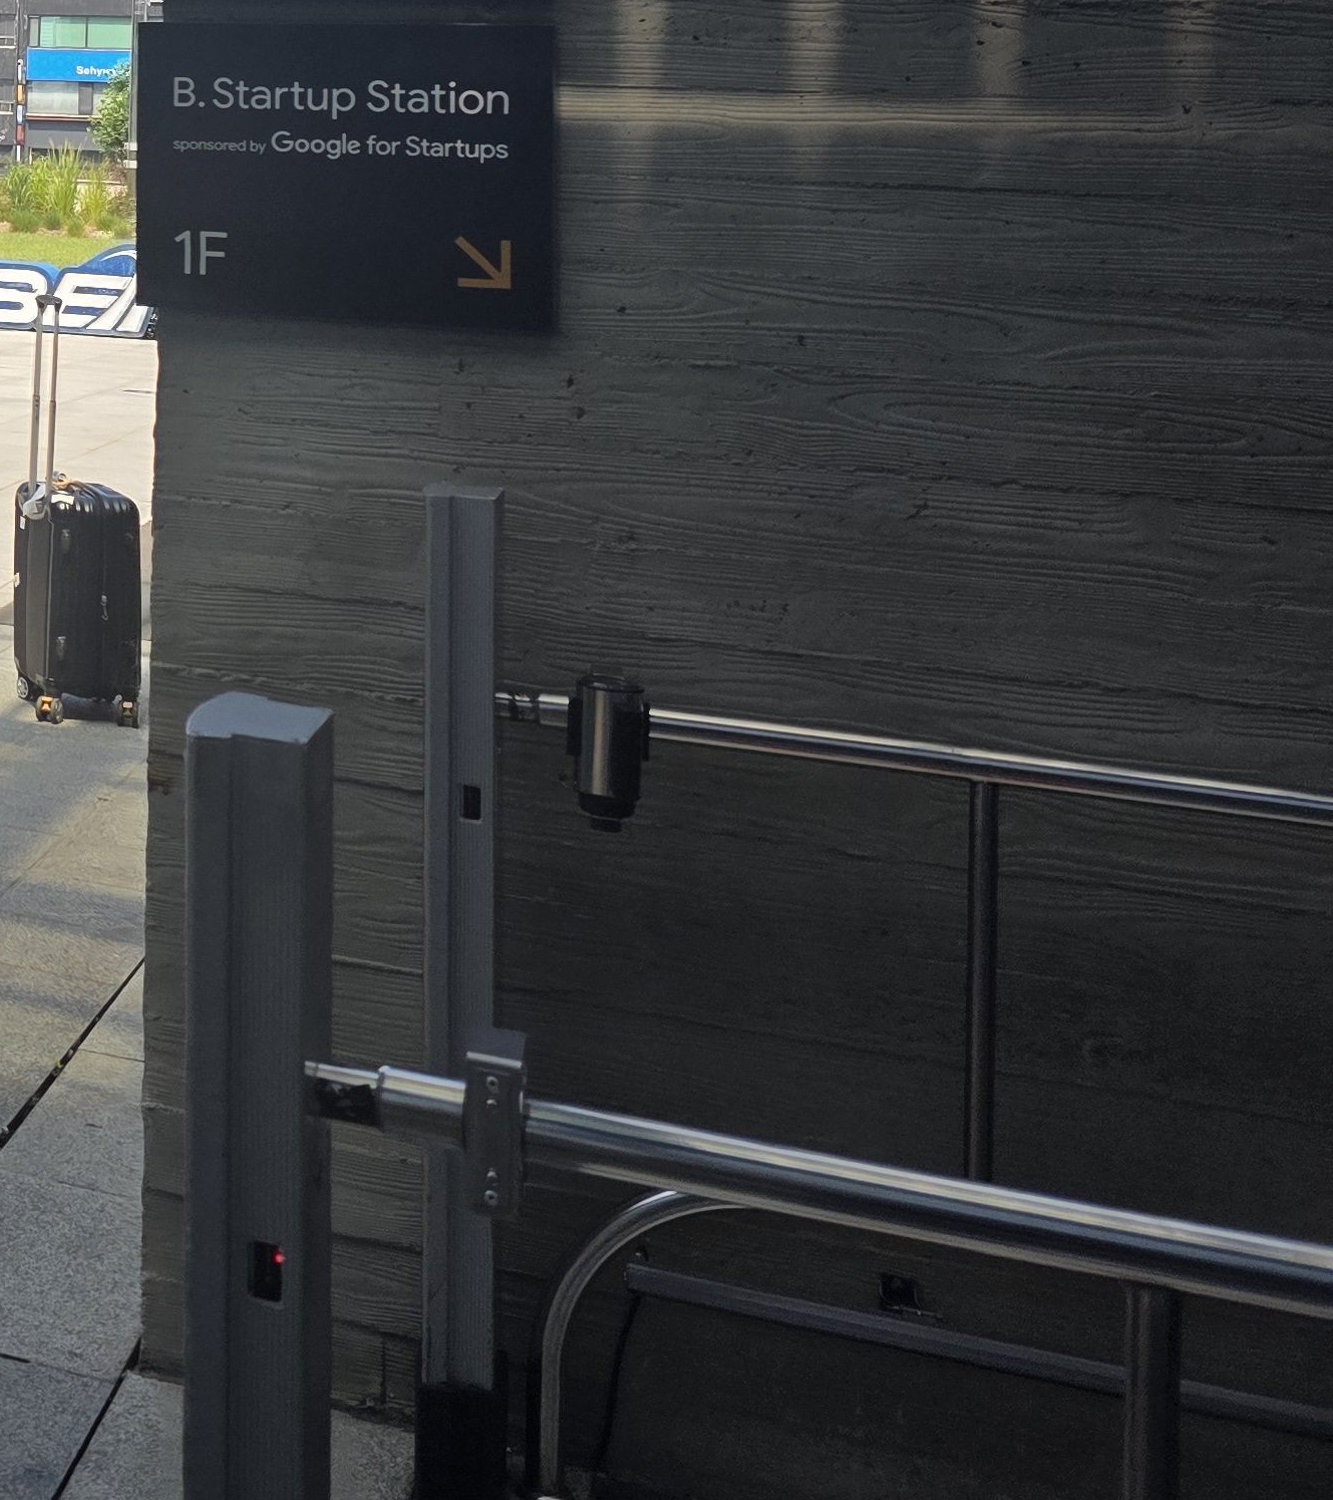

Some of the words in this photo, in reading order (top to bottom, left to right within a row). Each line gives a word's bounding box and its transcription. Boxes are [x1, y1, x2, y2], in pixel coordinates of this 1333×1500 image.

[367, 79, 510, 115] Station
[173, 137, 247, 154] sponsored
[249, 138, 267, 155] by
[271, 130, 361, 160] Google
[366, 134, 401, 157] for
[405, 135, 509, 164] Startups
[174, 230, 228, 275] 1F
